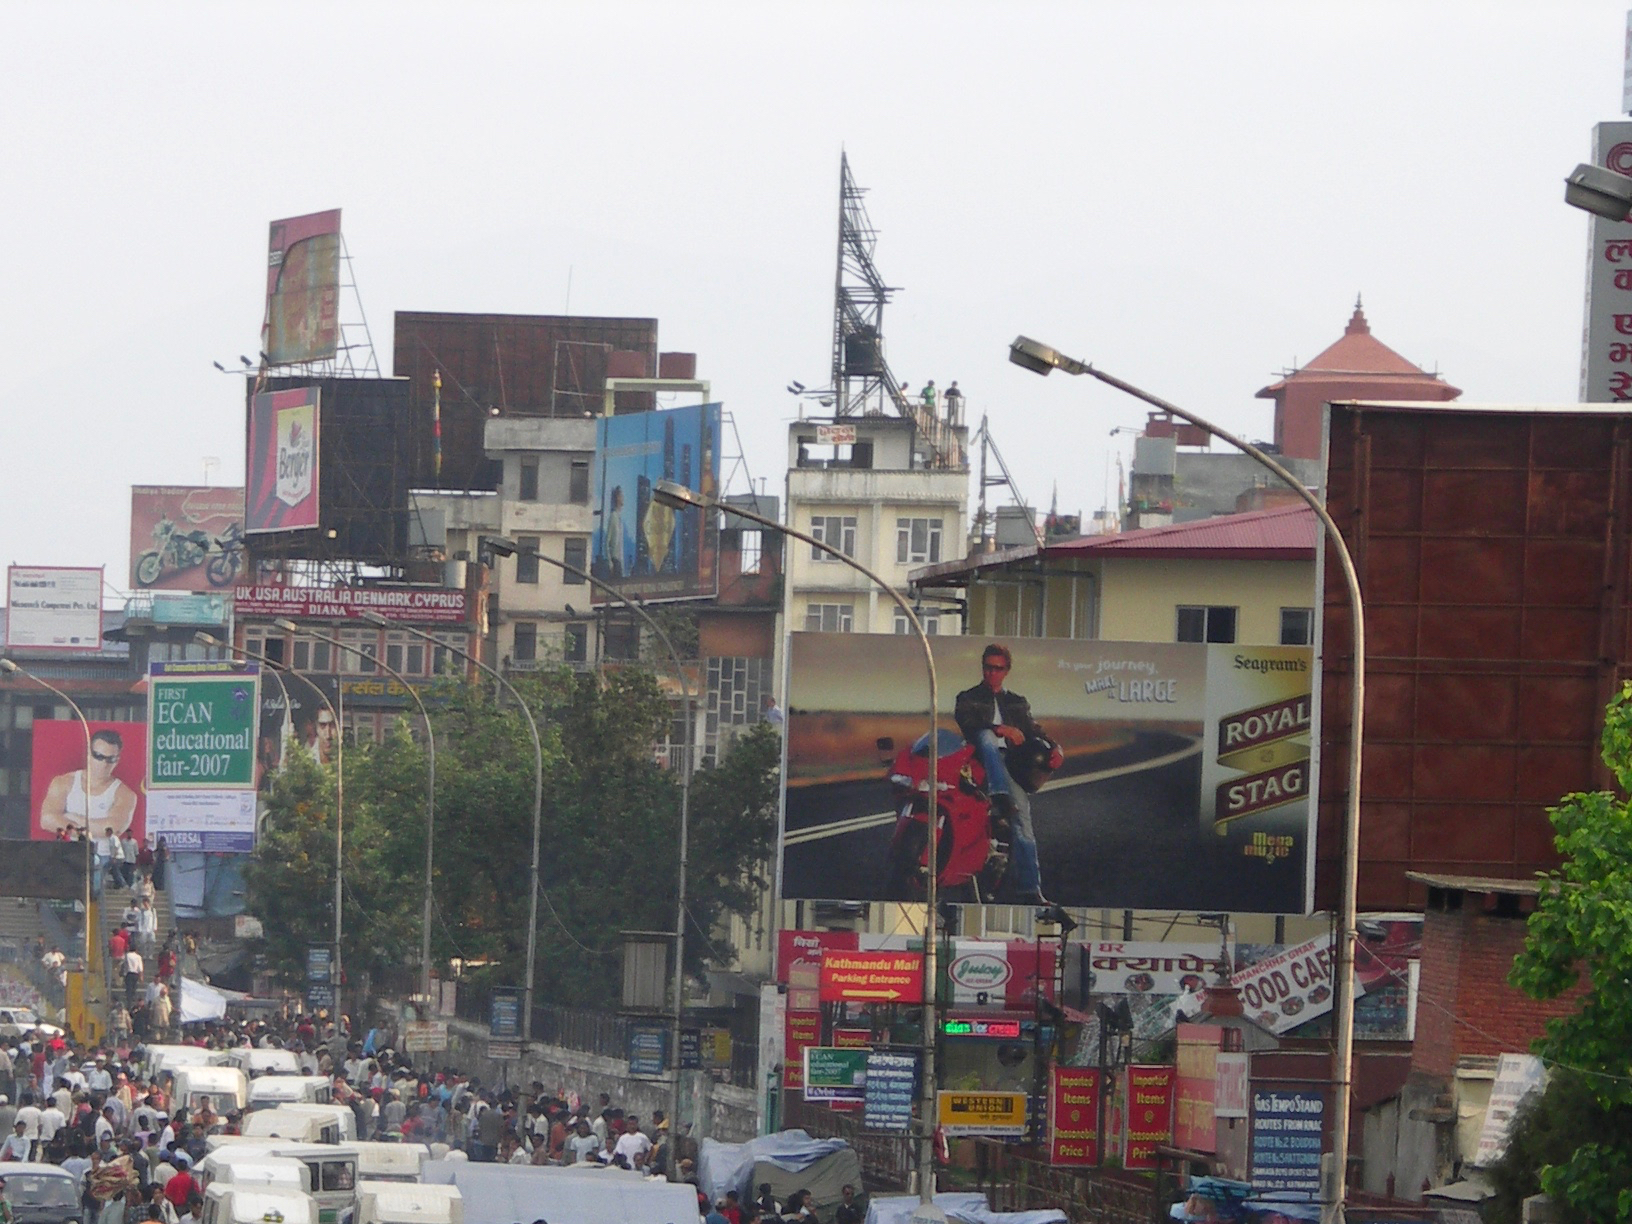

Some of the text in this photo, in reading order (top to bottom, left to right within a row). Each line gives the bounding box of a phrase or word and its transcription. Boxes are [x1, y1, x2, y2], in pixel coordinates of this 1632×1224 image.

[309, 604, 347, 616] DIANA
[1094, 659, 1159, 674] journey,
[1234, 655, 1307, 673] Seagram's
[158, 688, 187, 700] FIRST
[1085, 675, 1117, 694] MAKE
[1119, 679, 1177, 703] LARGE
[157, 702, 213, 724] ECAN
[1226, 702, 1311, 746] ROYAL
[157, 727, 250, 750] educational
[157, 754, 231, 776] fair-2007
[1229, 768, 1302, 810] STAG
[825, 956, 919, 970] Kathmandu Mall
[832, 973, 911, 984] Parking Entrance
[1241, 970, 1290, 1009] OOD
[1060, 1075, 1094, 1088] Imported
[1133, 1075, 1168, 1088] Imported
[1063, 1093, 1091, 1105] Items
[1136, 1092, 1165, 1104] Items
[1255, 1094, 1323, 1113] GAS TEMPO STAND
[968, 1104, 1003, 1112] UNION
[1254, 1119, 1282, 1130] ROUTES
[1060, 1145, 1083, 1157] Price
